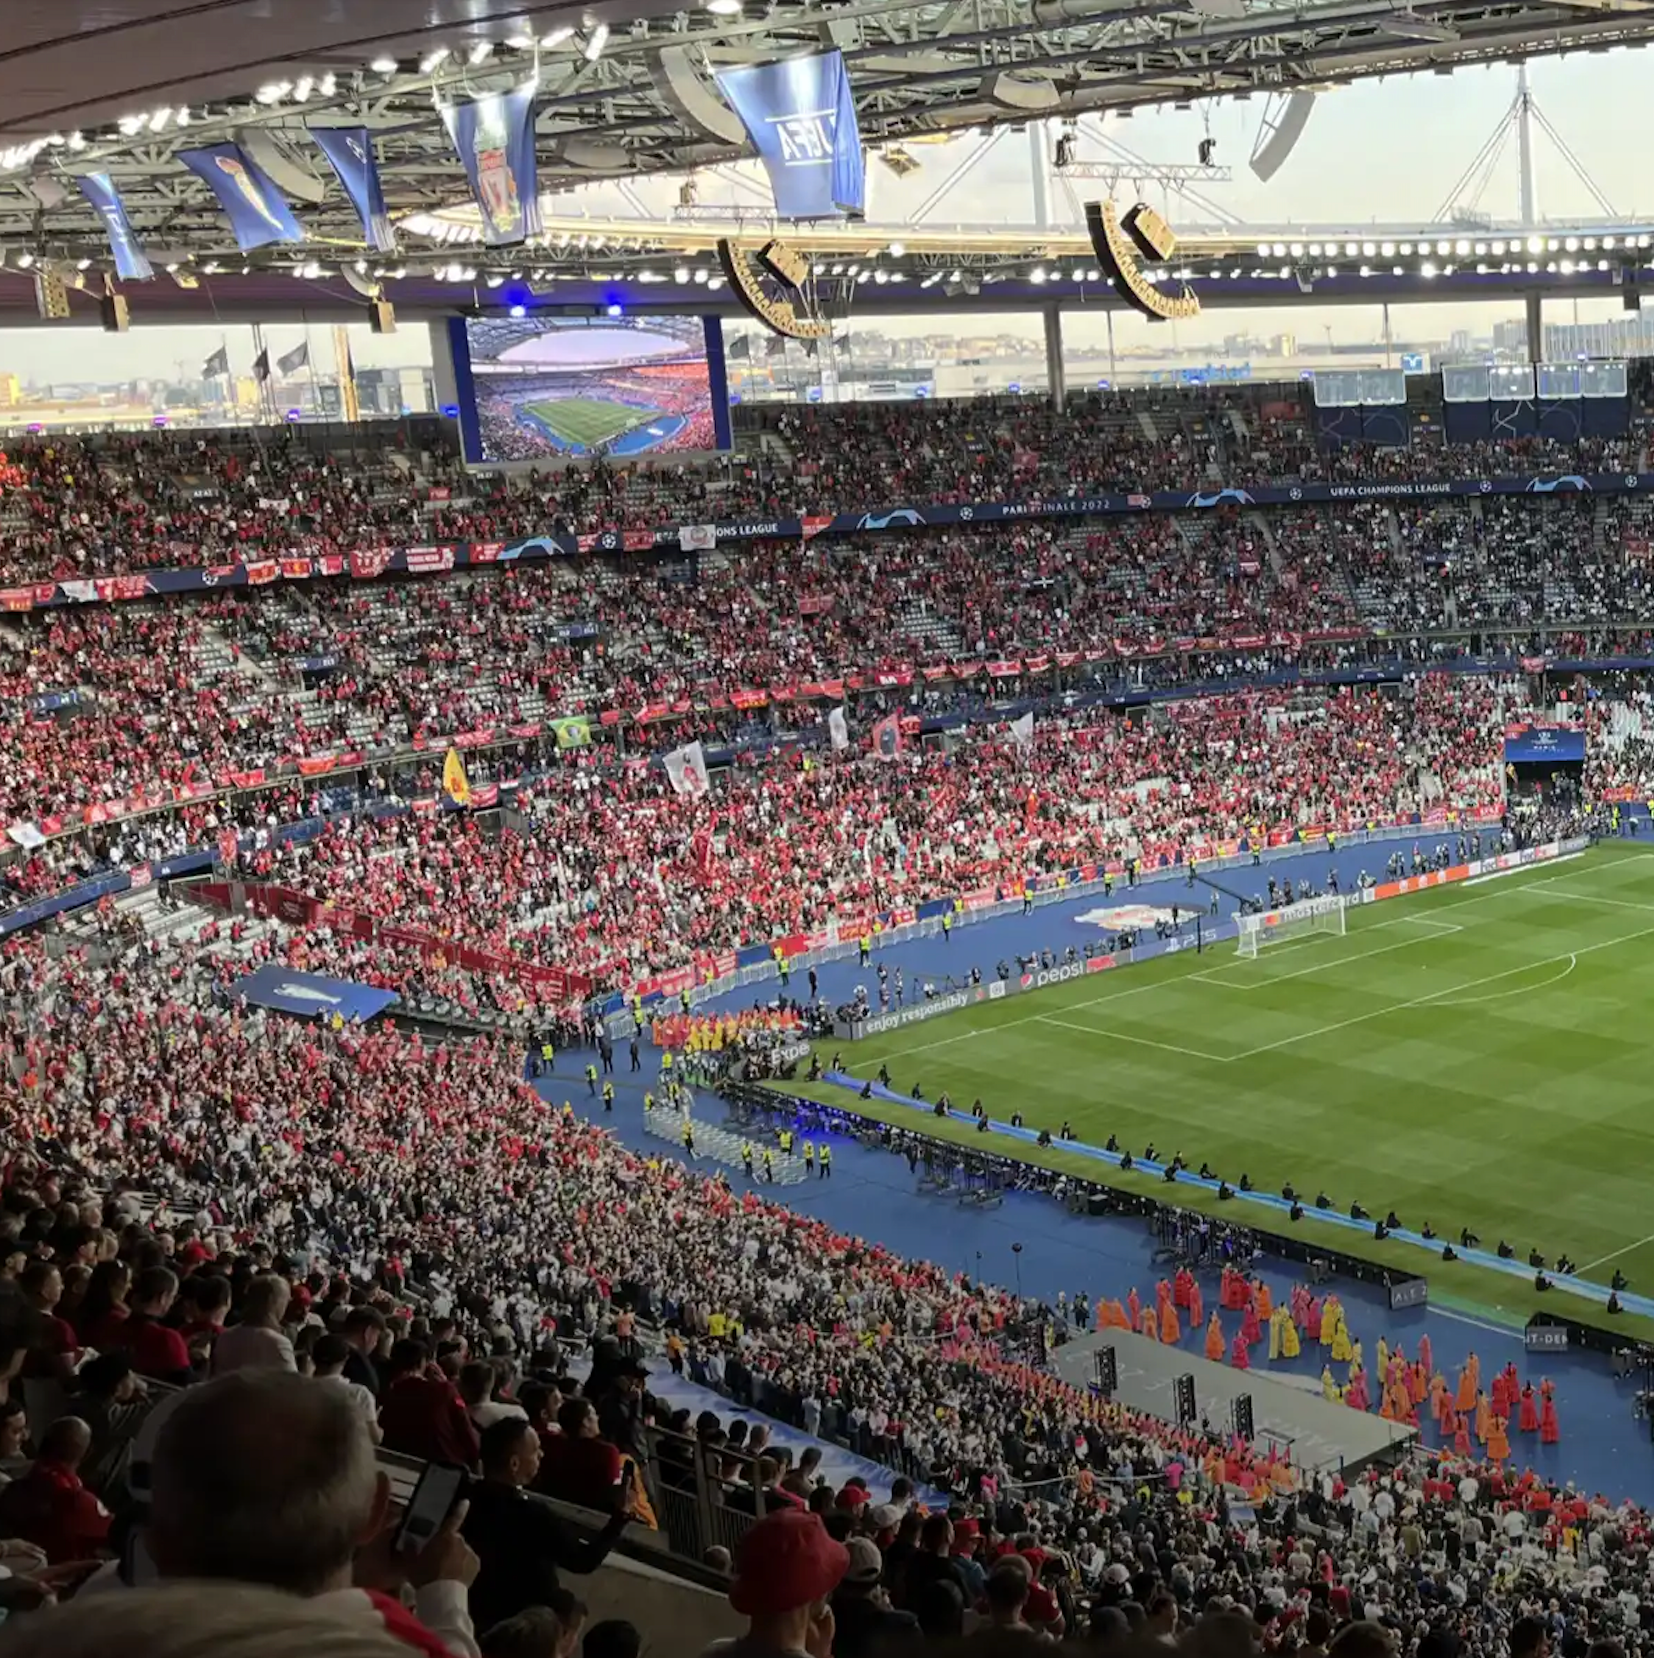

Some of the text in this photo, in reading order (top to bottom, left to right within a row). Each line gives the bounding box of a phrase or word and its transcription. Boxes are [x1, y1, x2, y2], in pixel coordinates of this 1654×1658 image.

[1330, 482, 1452, 498] UEFA CHAMPIONS LEAGUE
[1002, 502, 1032, 516] PARI
[1081, 500, 1111, 512] 2022
[739, 523, 779, 536] LEAGUE
[1182, 928, 1217, 947] PS5
[1037, 960, 1085, 988] pepsi
[866, 993, 968, 1035] enjoy responsibly
